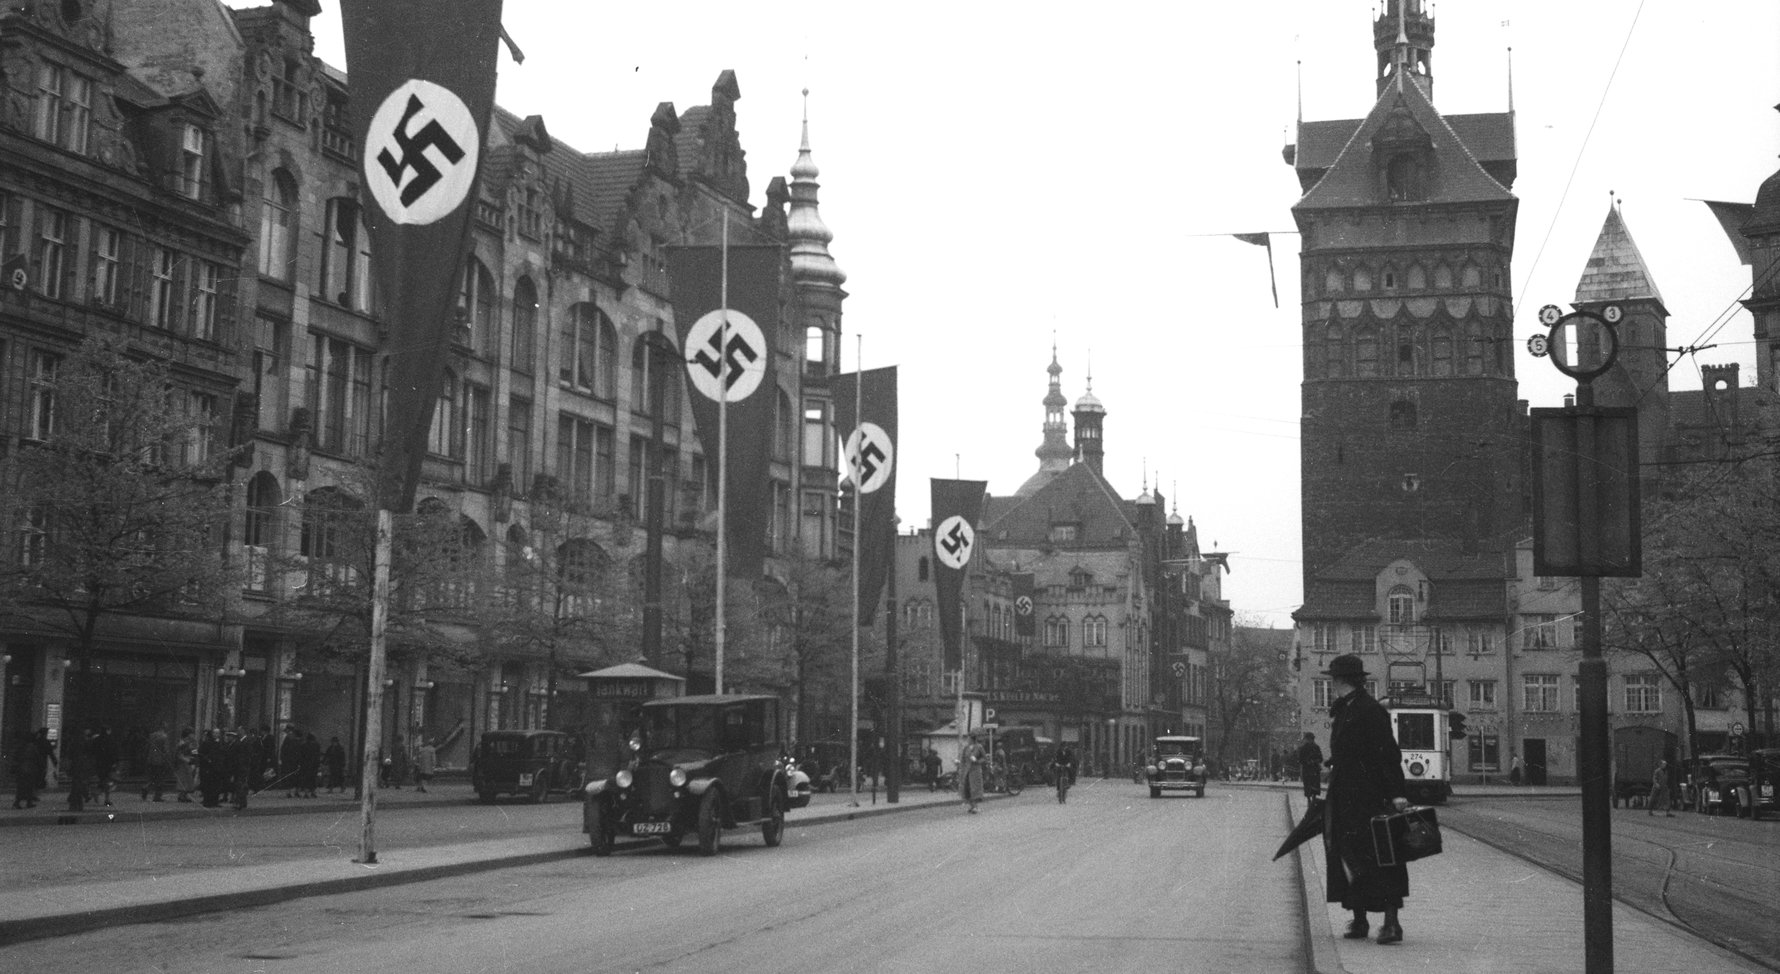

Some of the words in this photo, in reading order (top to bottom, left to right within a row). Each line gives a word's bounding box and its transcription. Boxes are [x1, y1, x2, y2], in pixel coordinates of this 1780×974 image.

[1546, 310, 1554, 321] 4
[1608, 308, 1616, 320] 3
[1535, 340, 1543, 351] 5
[985, 708, 996, 722] P
